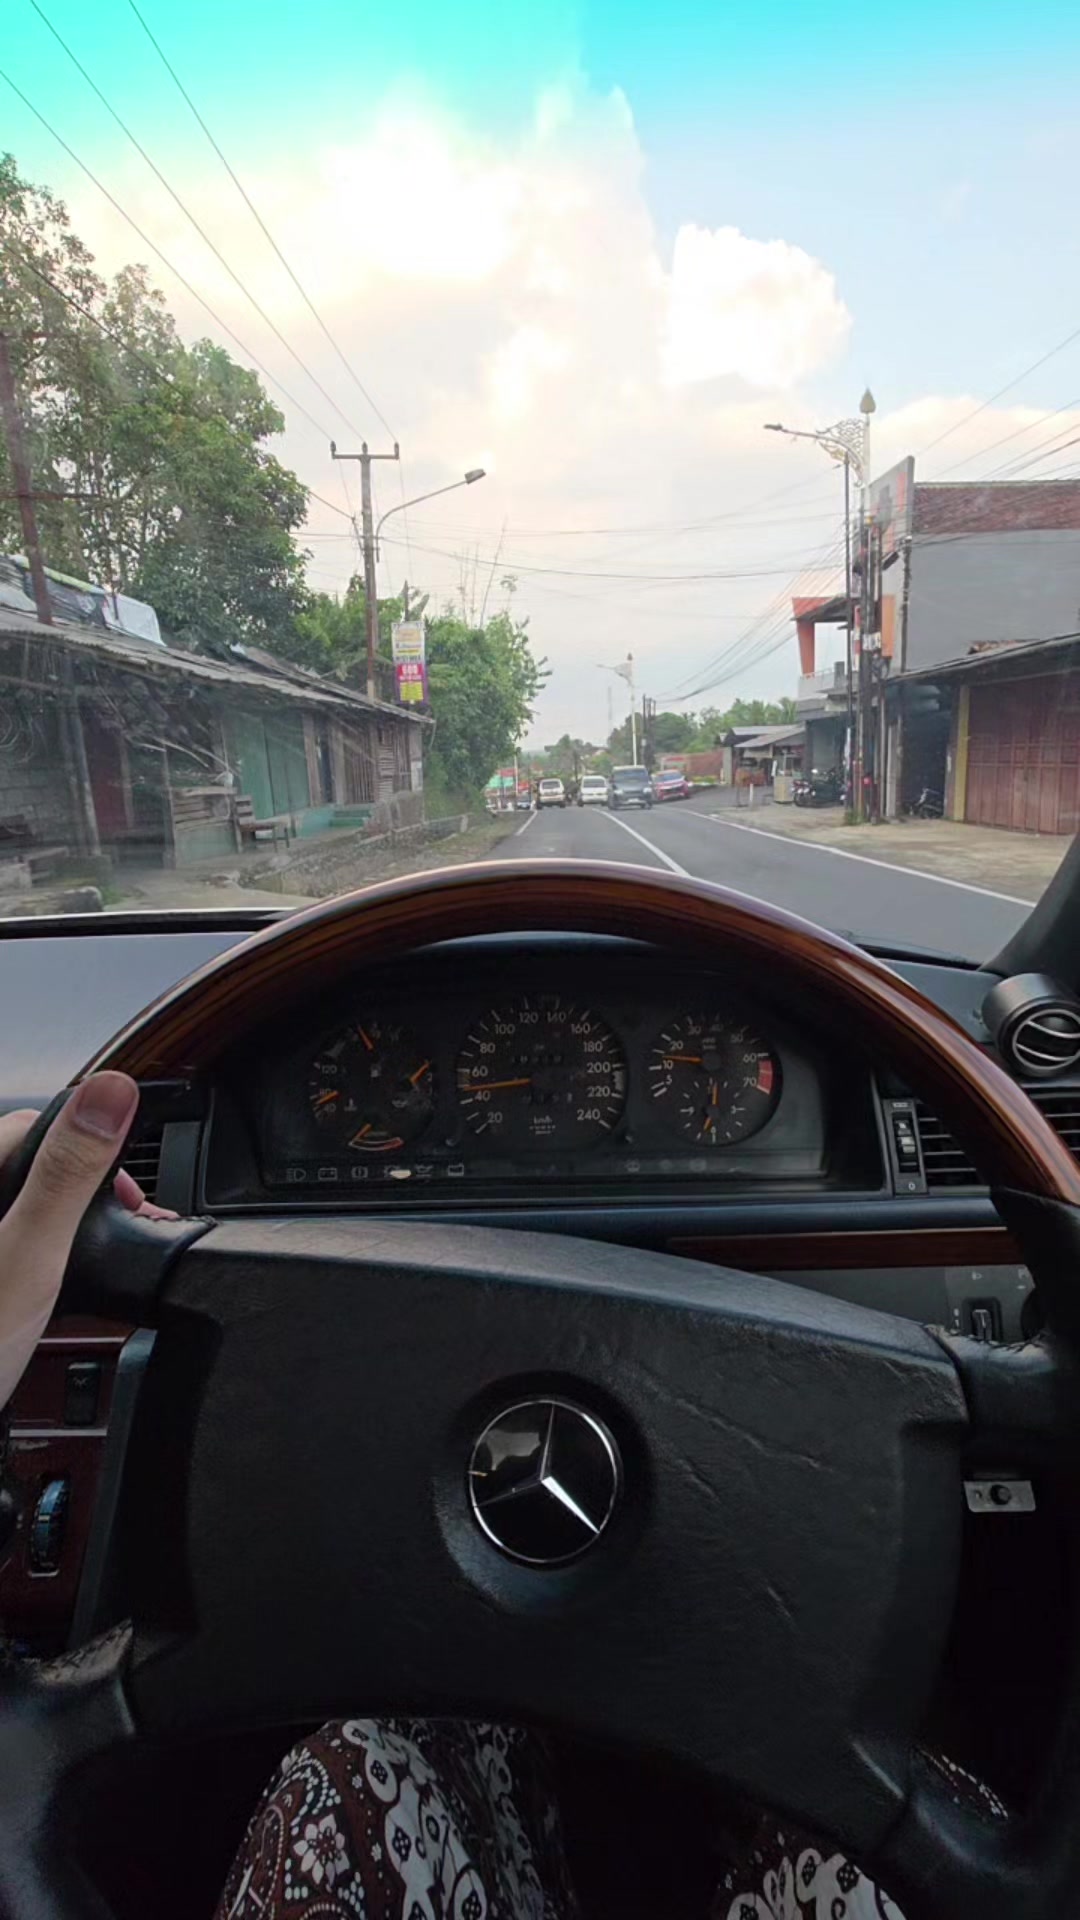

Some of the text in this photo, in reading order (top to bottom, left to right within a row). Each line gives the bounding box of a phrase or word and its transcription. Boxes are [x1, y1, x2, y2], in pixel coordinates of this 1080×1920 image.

[519, 1012, 539, 1023] 120
[547, 1012, 566, 1023] 140
[495, 1024, 515, 1034] 100
[571, 1023, 591, 1034] 160
[480, 1042, 496, 1053] 80
[583, 1041, 603, 1052] 180
[670, 1040, 684, 1050] 20
[743, 1053, 757, 1063] 60
[587, 1062, 611, 1073] 200
[663, 1060, 674, 1069] 10
[471, 1066, 489, 1077] 60
[666, 1075, 673, 1085] 5
[743, 1077, 757, 1087] 70
[474, 1090, 491, 1101] 40
[587, 1086, 611, 1098] 220
[487, 1111, 503, 1123] 20
[576, 1109, 601, 1120] 240
